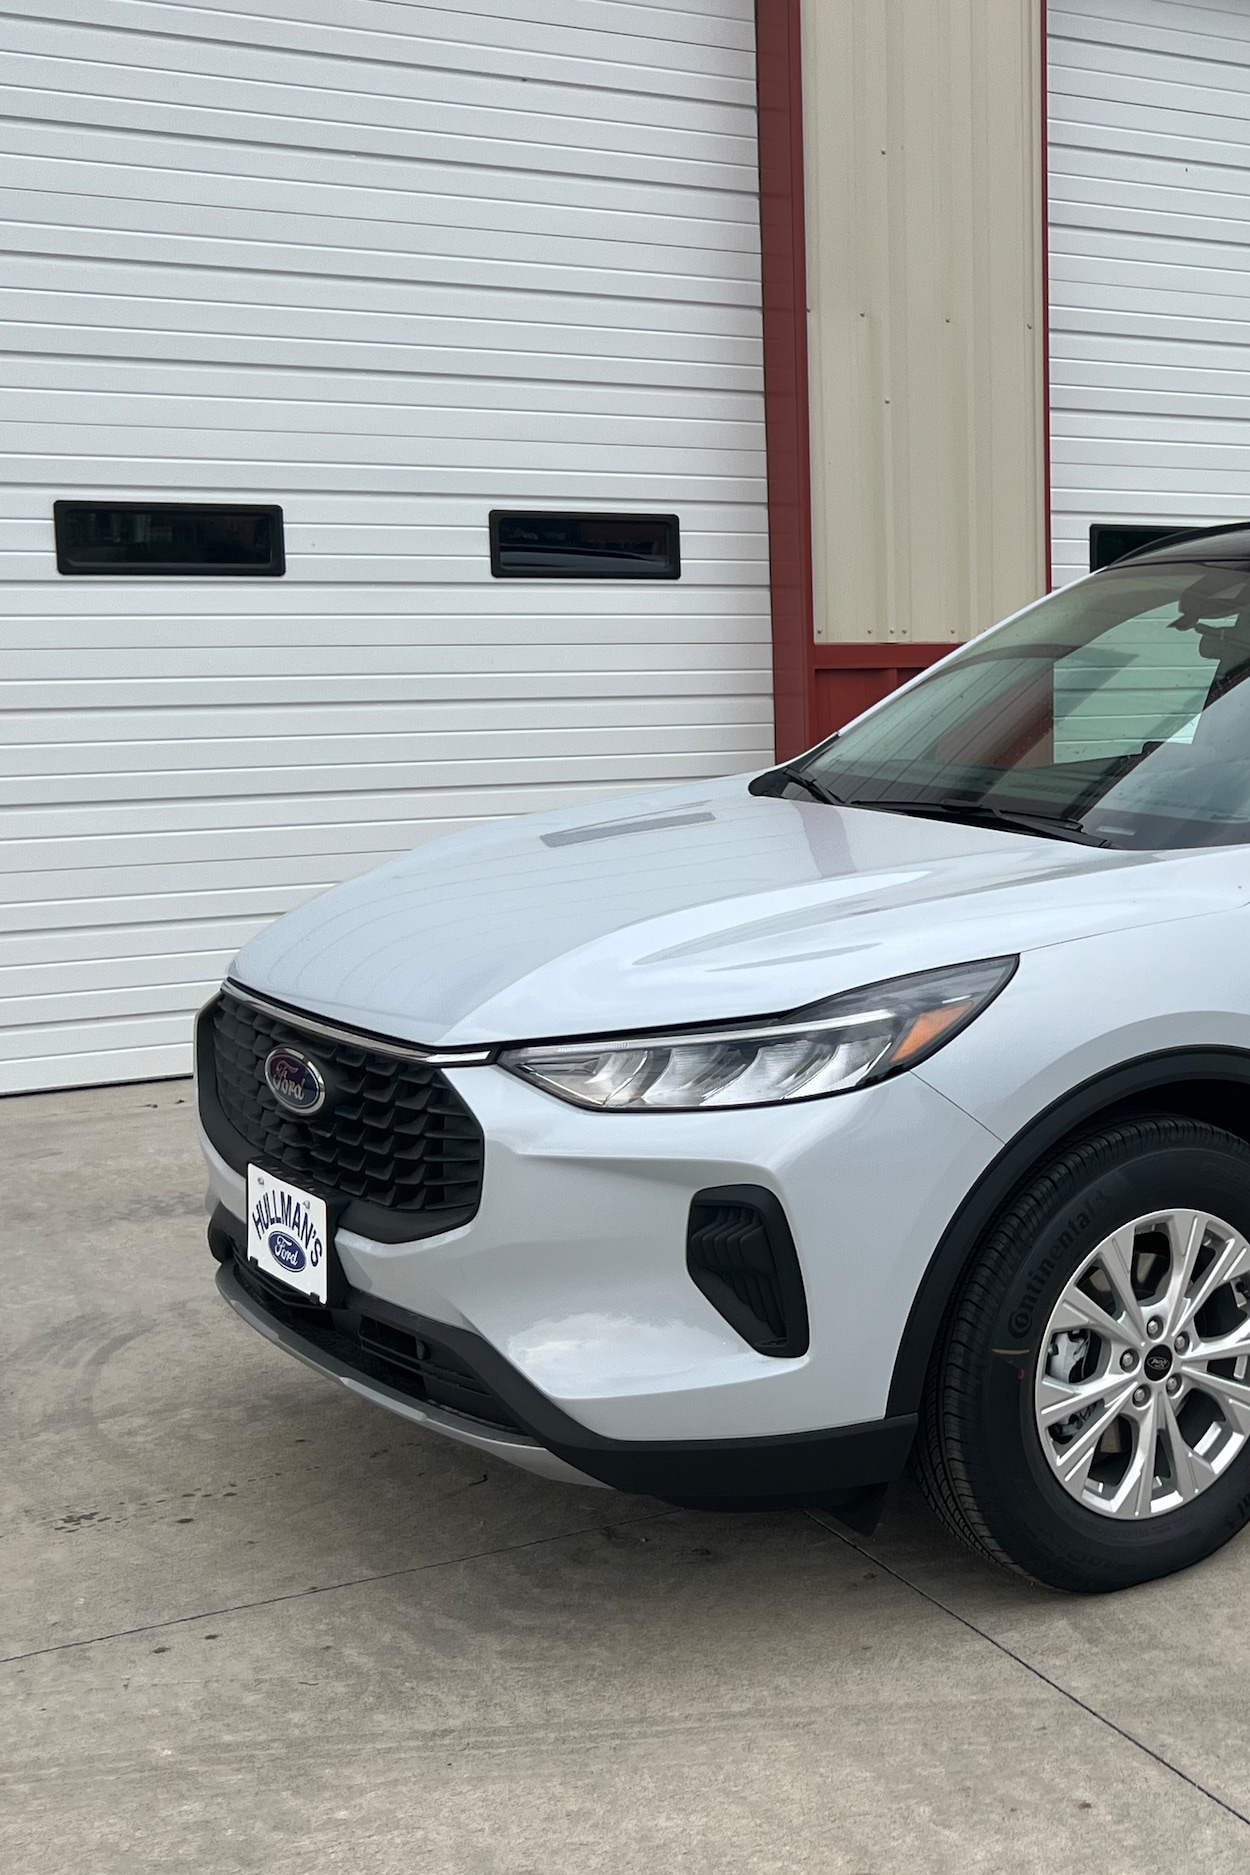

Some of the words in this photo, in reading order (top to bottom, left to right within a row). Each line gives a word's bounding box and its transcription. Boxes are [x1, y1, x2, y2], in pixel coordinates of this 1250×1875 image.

[272, 1060, 304, 1101] Ford
[251, 1189, 323, 1267] HULLMAN'S
[273, 1234, 299, 1266] Ford
[1008, 1200, 1097, 1338] Continental
